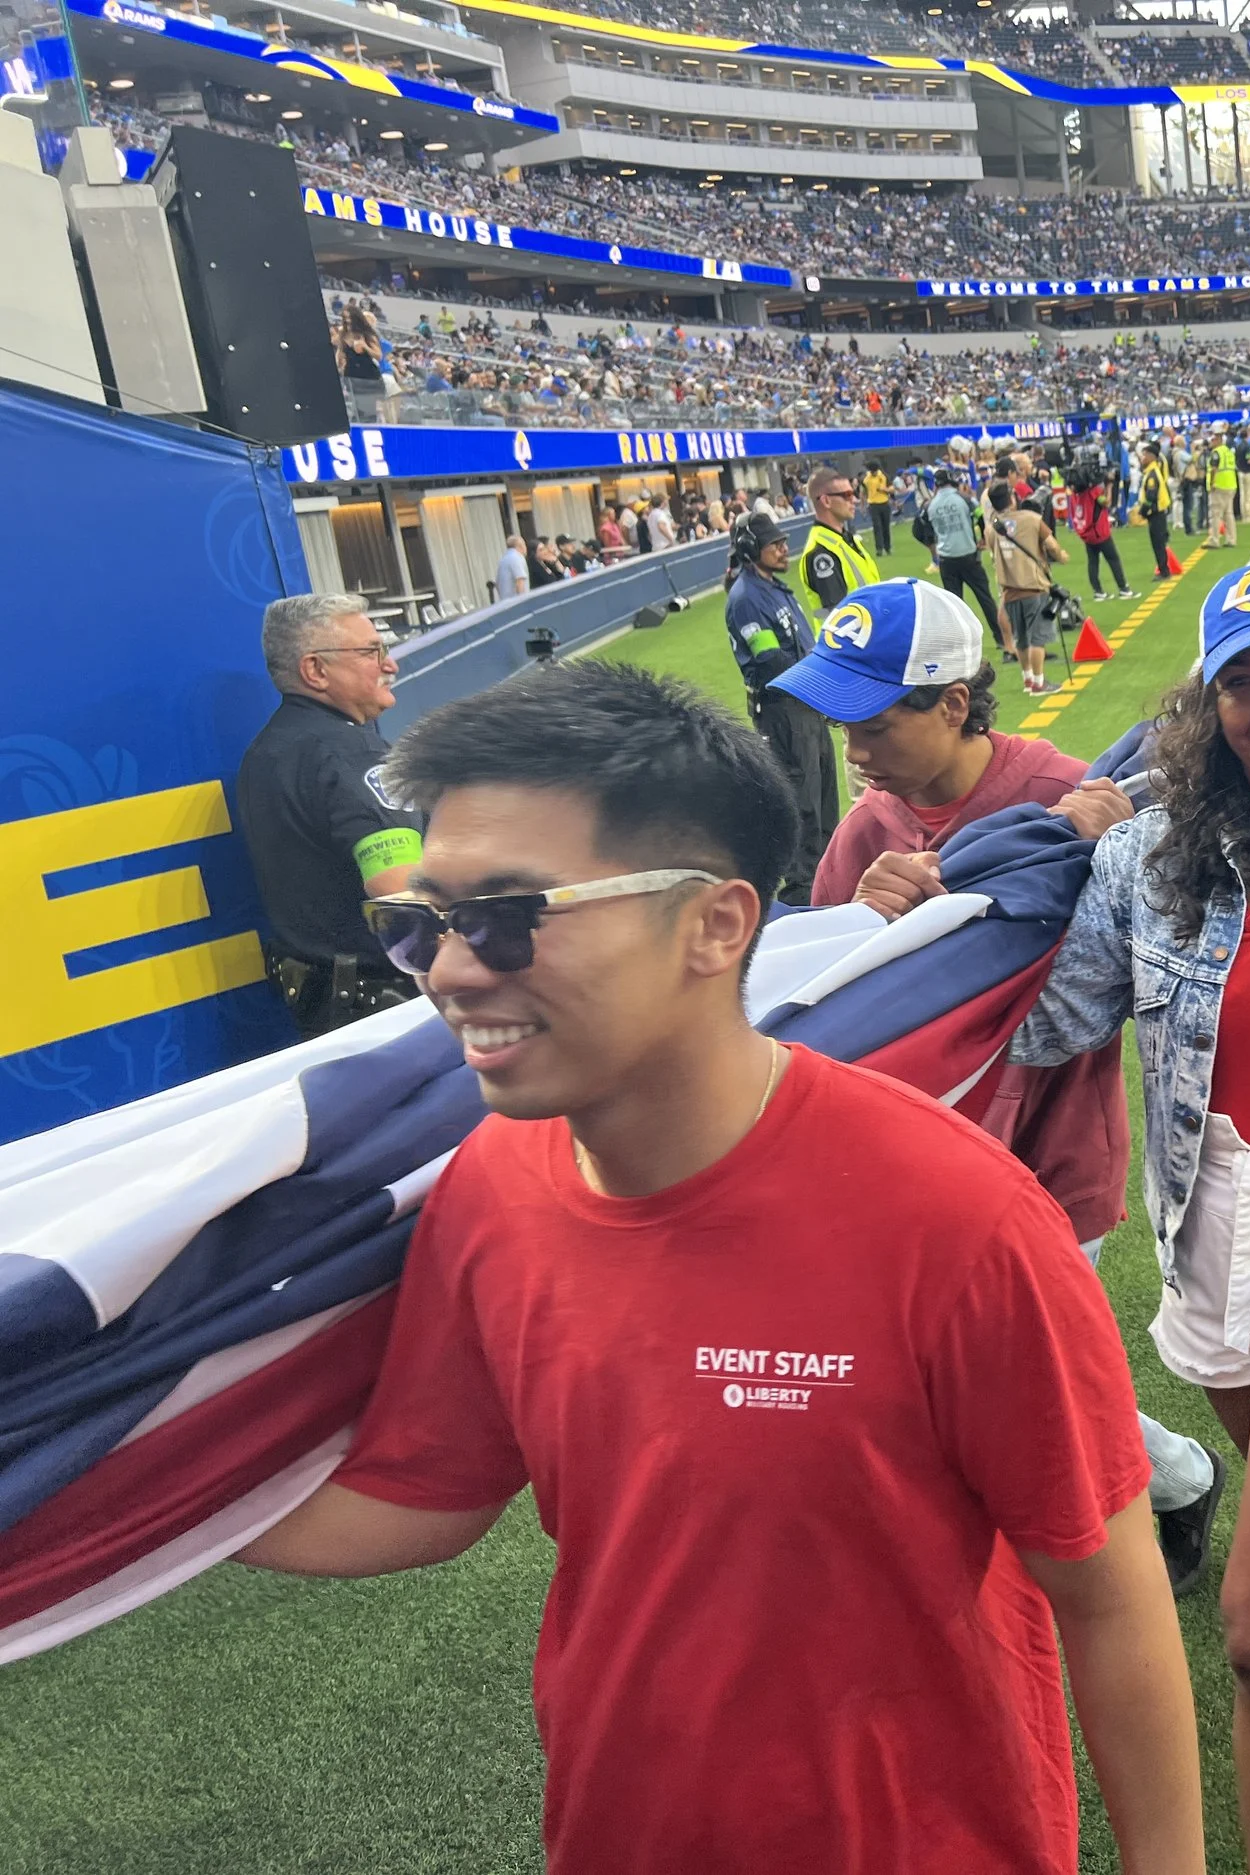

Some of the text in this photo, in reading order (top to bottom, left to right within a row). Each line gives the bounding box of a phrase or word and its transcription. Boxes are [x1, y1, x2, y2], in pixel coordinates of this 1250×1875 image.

[122, 8, 166, 31] RAMS
[1216, 89, 1247, 99] LOS
[404, 207, 513, 249] HOUSE
[930, 280, 1038, 296] WELCOME
[1049, 281, 1077, 295] TO
[1091, 280, 1135, 294] THE
[1148, 277, 1211, 292] RAMS
[618, 431, 746, 464] RAMS HOUSE
[696, 1347, 856, 1379] EVENT STAFF
[746, 1387, 812, 1403] LIBERTY
